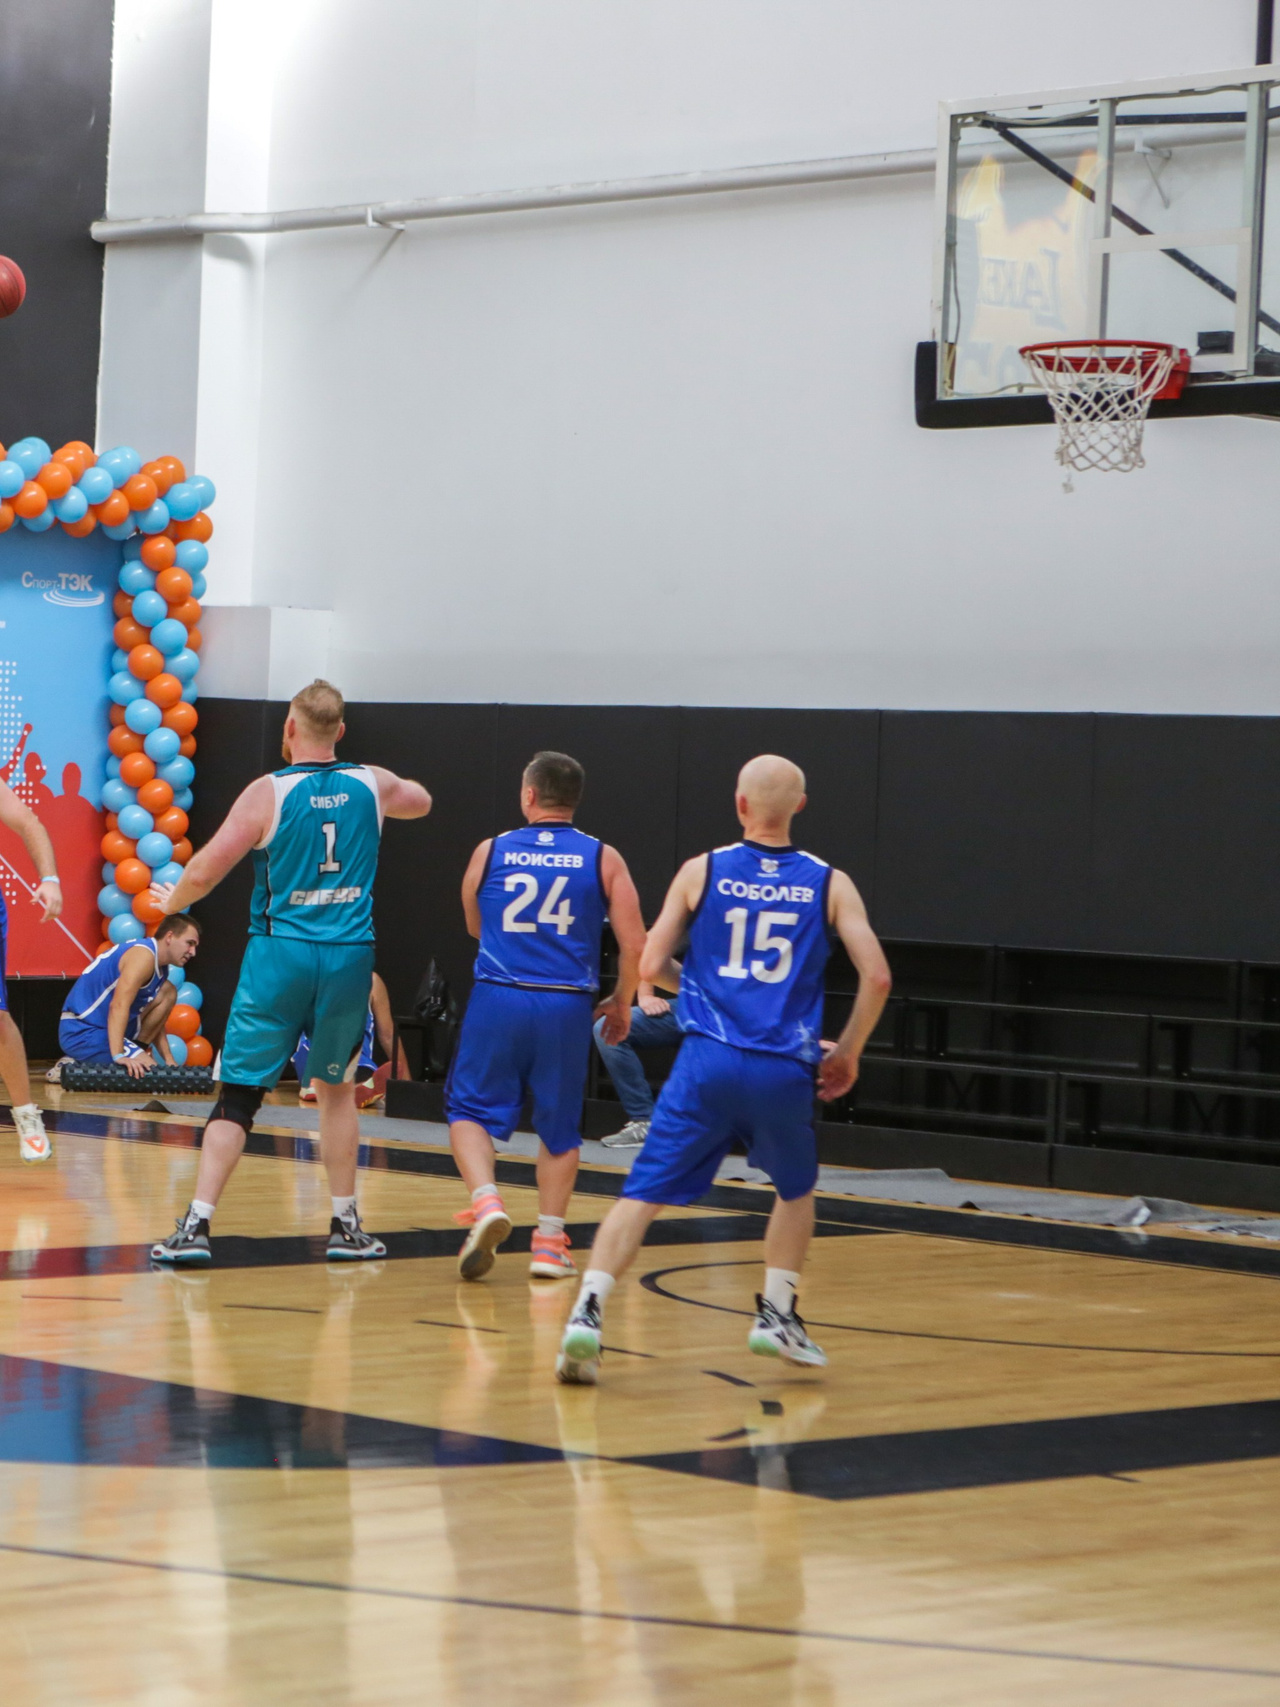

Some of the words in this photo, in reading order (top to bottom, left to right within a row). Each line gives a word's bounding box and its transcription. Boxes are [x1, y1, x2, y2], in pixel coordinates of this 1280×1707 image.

[310, 793, 349, 809] СИБУР
[318, 821, 341, 874] 1
[504, 852, 584, 868] МОИСЕЕВ
[289, 886, 362, 906] СИБУР
[717, 878, 815, 903] СОБОЛЕВ
[502, 872, 576, 936] 24
[717, 906, 800, 984] 15
